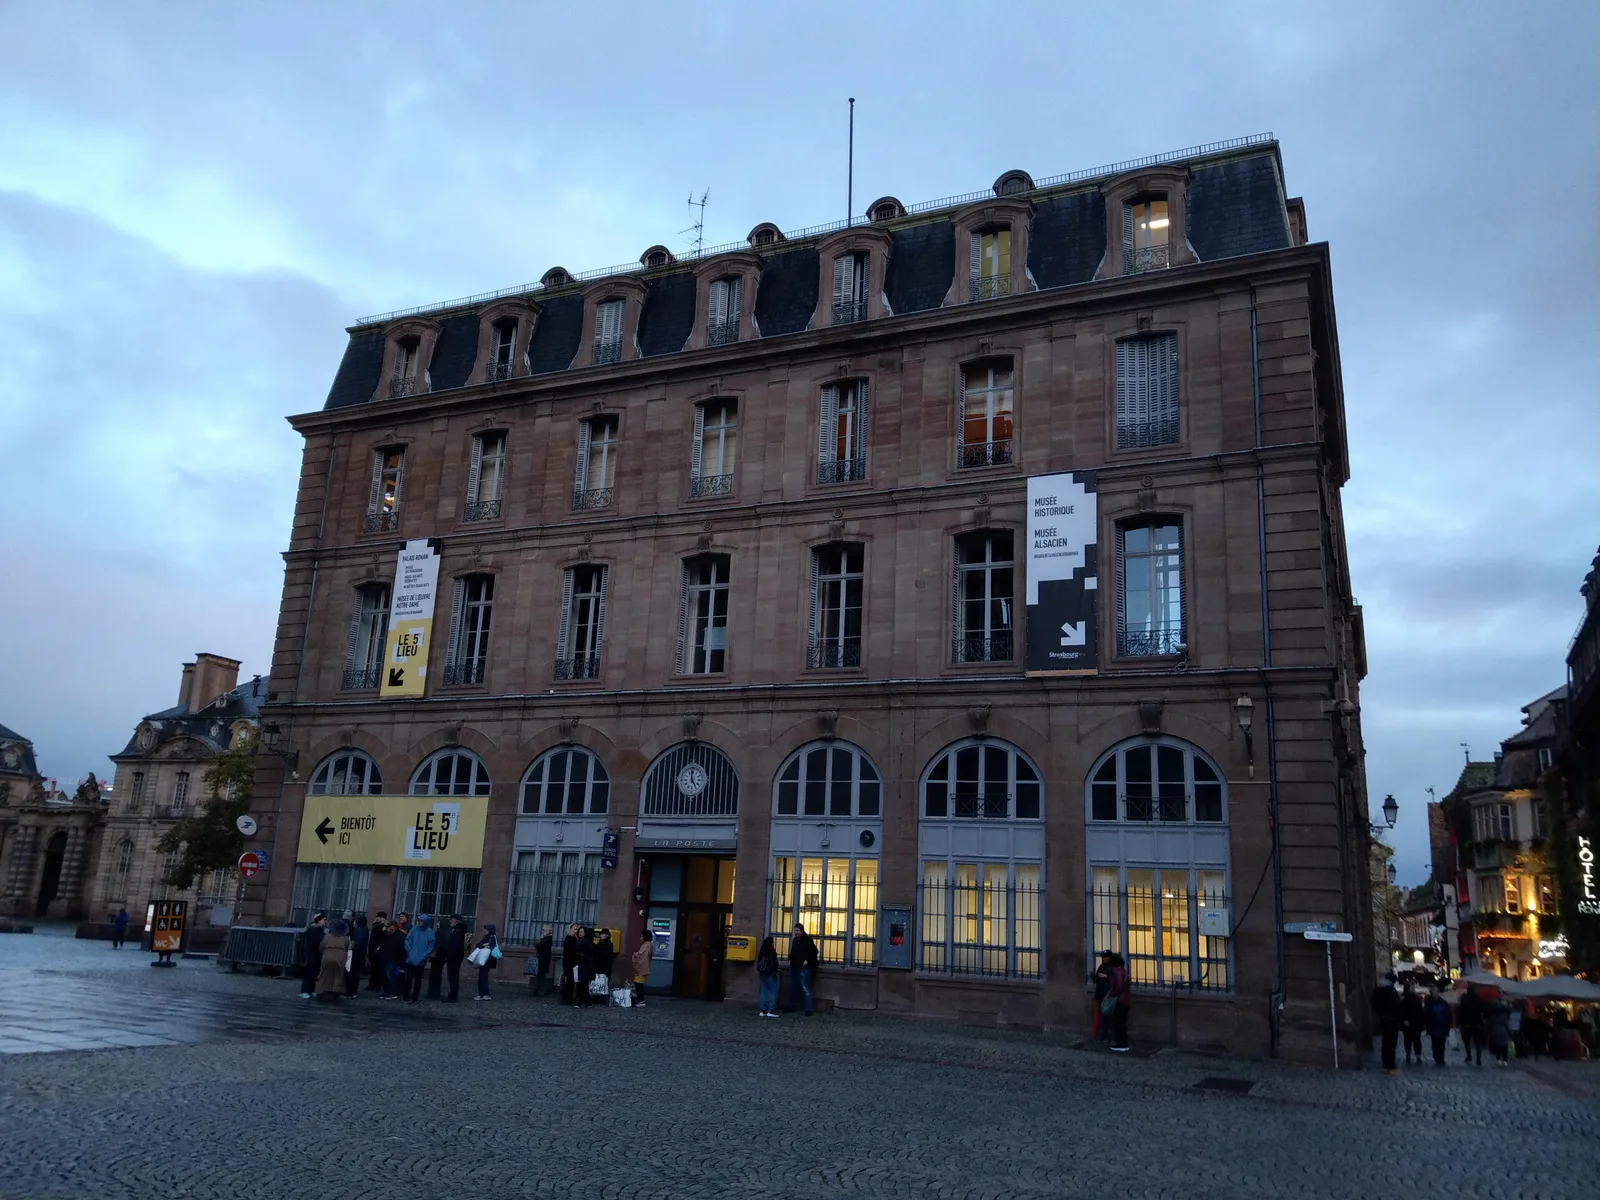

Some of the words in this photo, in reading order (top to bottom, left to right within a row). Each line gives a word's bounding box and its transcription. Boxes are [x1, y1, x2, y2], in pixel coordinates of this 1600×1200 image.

[1034, 495, 1058, 507] MUSÉE
[1034, 505, 1075, 518] HISTORIQUE
[1034, 526, 1058, 538] MUSÉE
[1034, 537, 1068, 549] ALSACIEN
[398, 634, 409, 645] LE
[397, 645, 418, 657] LIEU
[341, 814, 376, 830] BIENTÔT
[415, 812, 434, 831] LE
[339, 832, 351, 845] ICI
[413, 831, 449, 851] LIEU
[155, 940, 168, 948] WC
